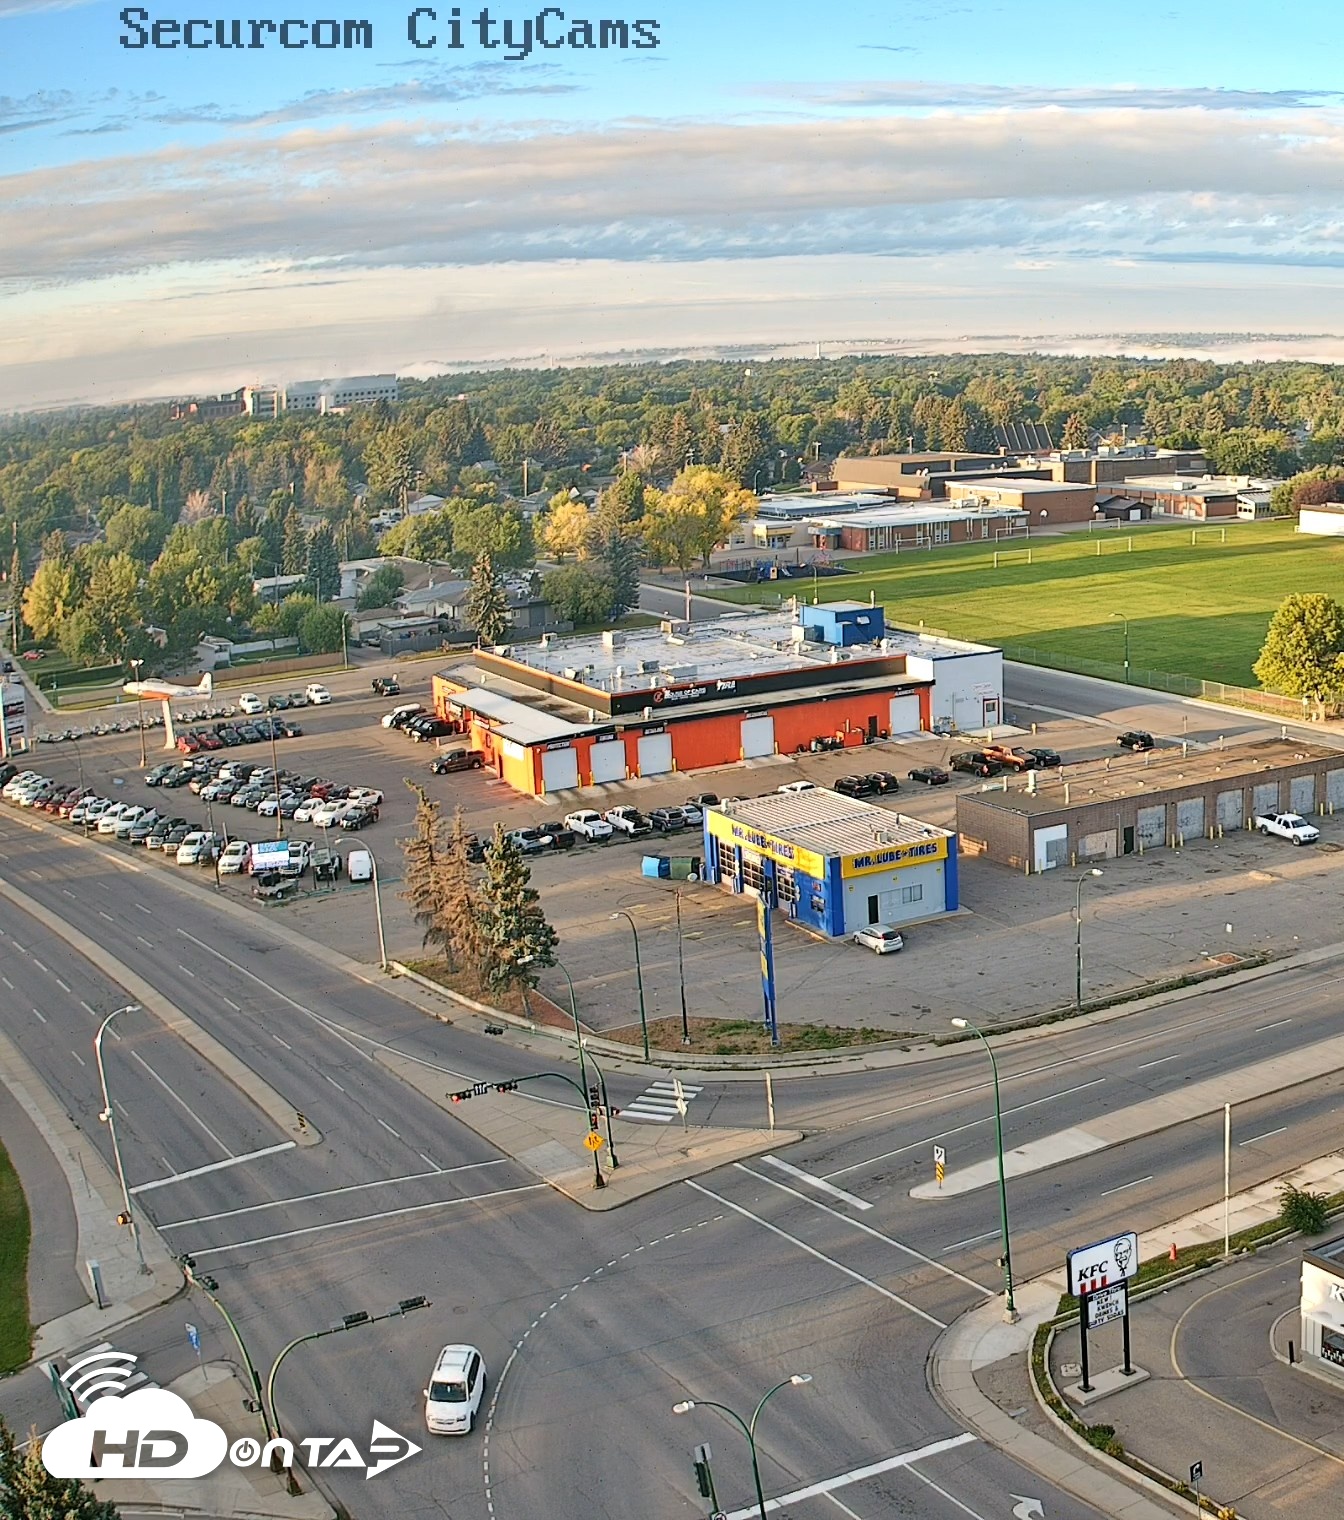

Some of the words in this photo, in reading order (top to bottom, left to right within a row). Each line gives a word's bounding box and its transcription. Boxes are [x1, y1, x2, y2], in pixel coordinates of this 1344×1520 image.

[876, 850, 901, 863] LUBE
[908, 842, 937, 857] TIRES
[1078, 1260, 1108, 1282] KFC
